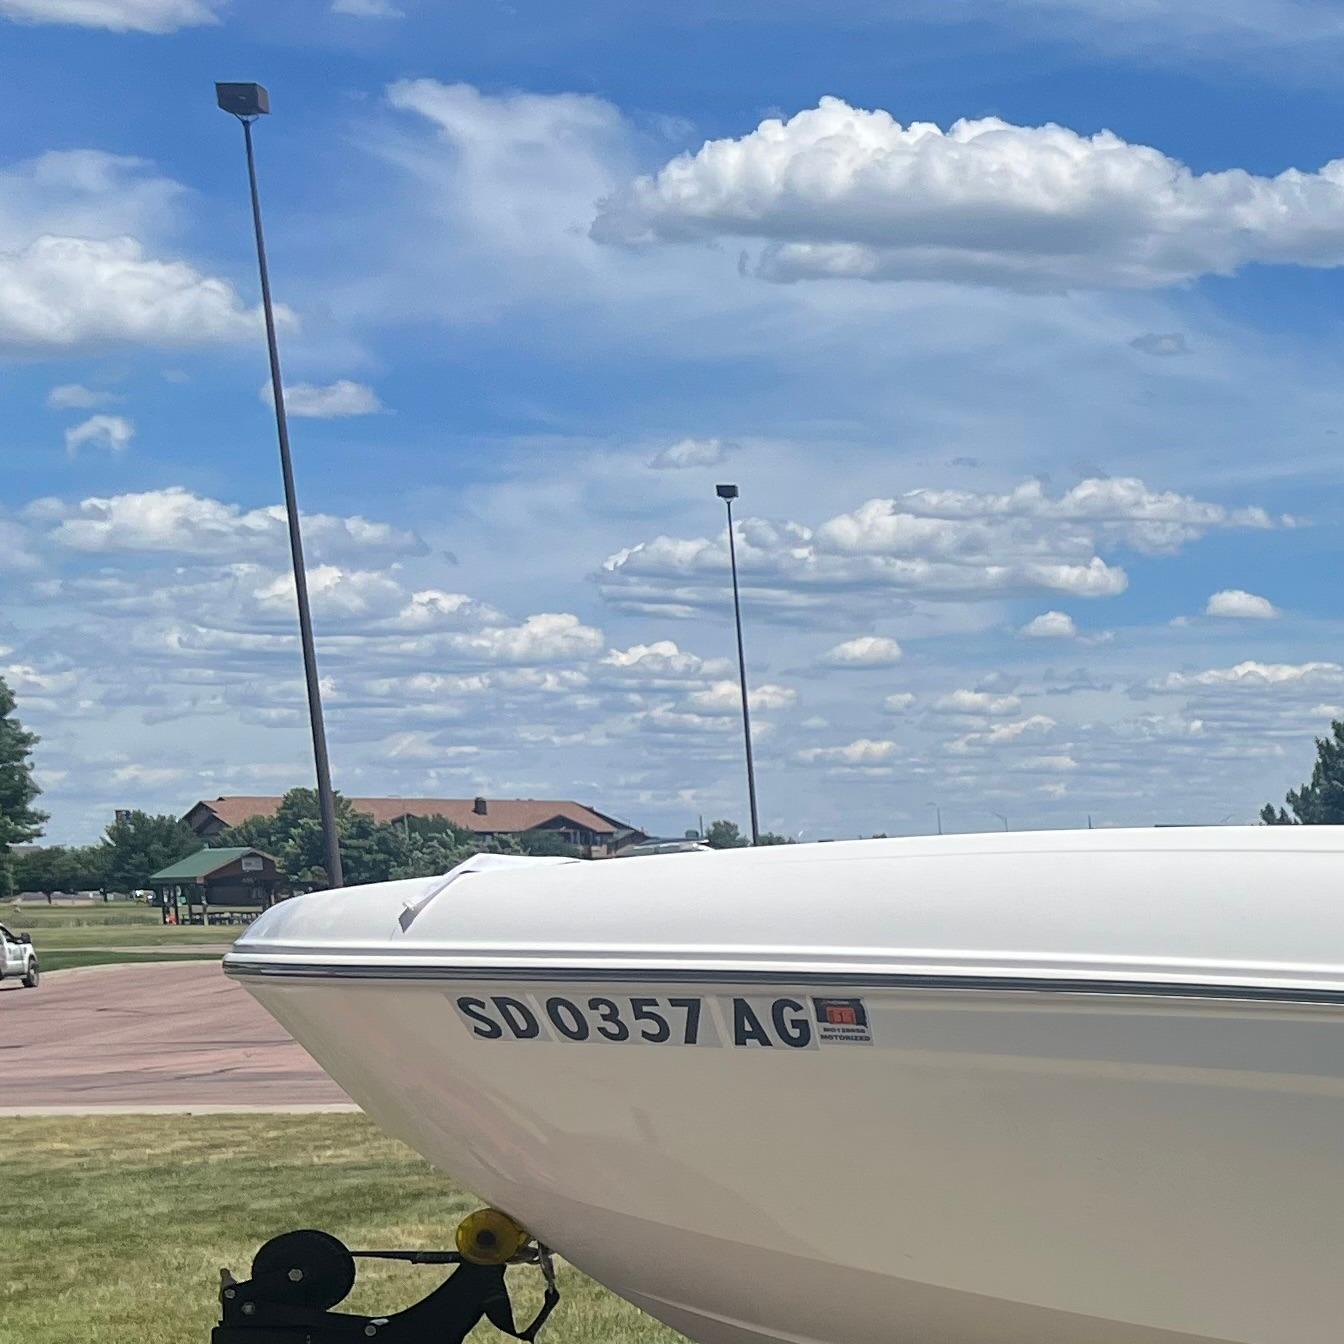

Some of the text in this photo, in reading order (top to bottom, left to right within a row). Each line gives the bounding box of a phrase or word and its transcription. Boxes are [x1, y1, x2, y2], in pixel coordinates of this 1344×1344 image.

[456, 996, 812, 1048] SD 0357 AG
